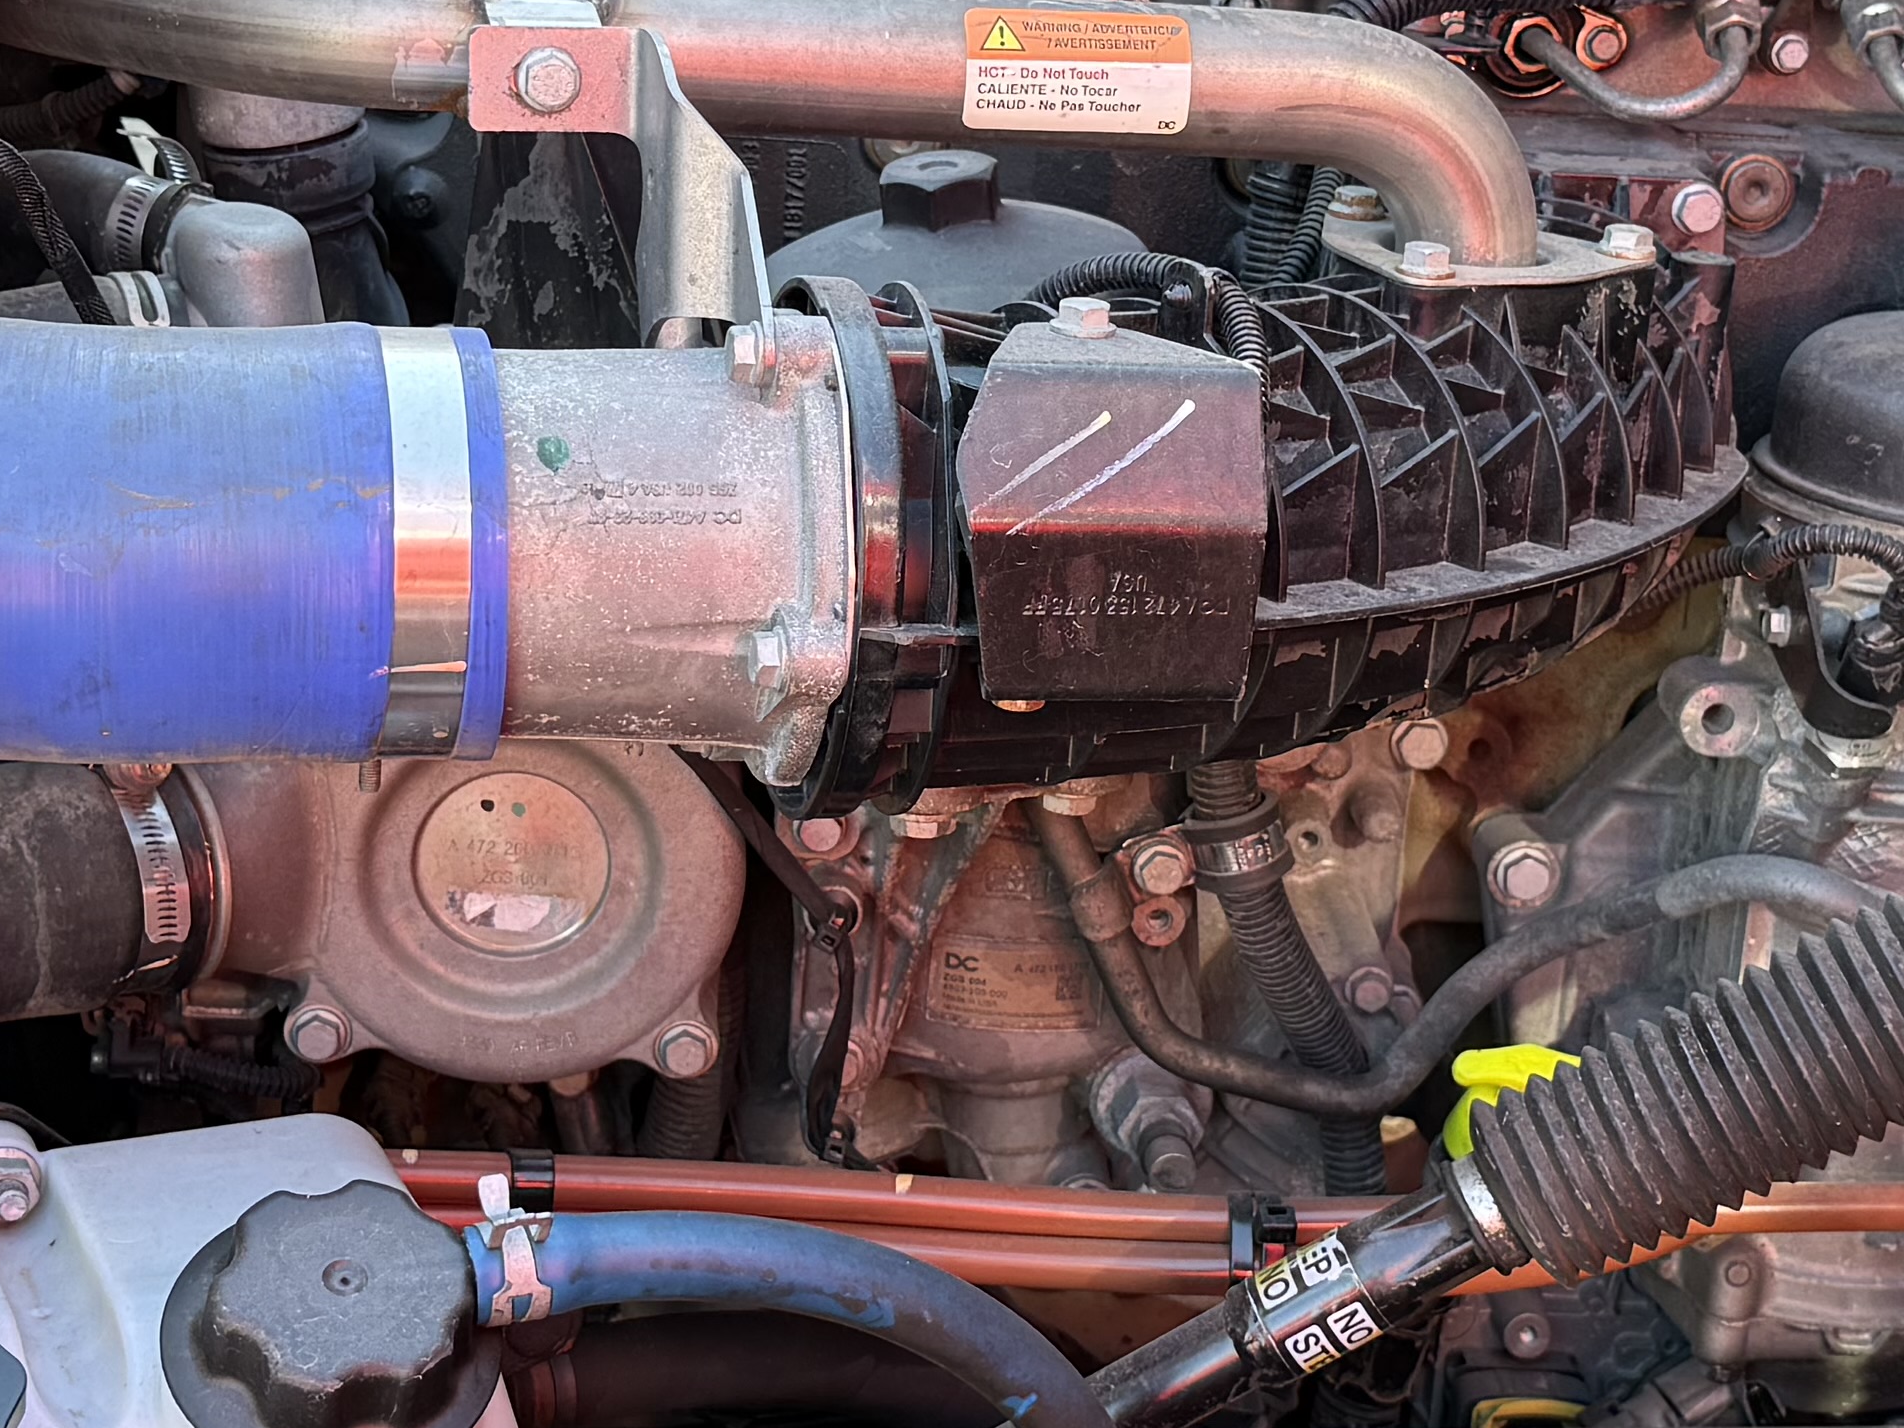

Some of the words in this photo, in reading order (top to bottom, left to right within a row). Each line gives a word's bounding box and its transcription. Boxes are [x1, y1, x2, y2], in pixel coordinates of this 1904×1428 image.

[1022, 21, 1082, 34] WARNING
[1091, 23, 1182, 37] ADVERTENCI
[1054, 38, 1157, 50] AVERTISSEMENT
[1020, 66, 1039, 79] Do
[1043, 67, 1065, 80] Not
[1070, 68, 1109, 80] Touch
[978, 83, 1047, 96] CALIENTE
[1060, 85, 1078, 96] No
[1083, 85, 1118, 97] Tocar
[976, 99, 1026, 110] CHAUD
[1039, 100, 1056, 111] Ne
[1061, 101, 1084, 112] Pas
[1088, 101, 1141, 113] Toucher
[1158, 121, 1176, 130] DC
[945, 952, 979, 972] DC
[1257, 1264, 1292, 1302] NO
[1334, 1308, 1376, 1344] NO
